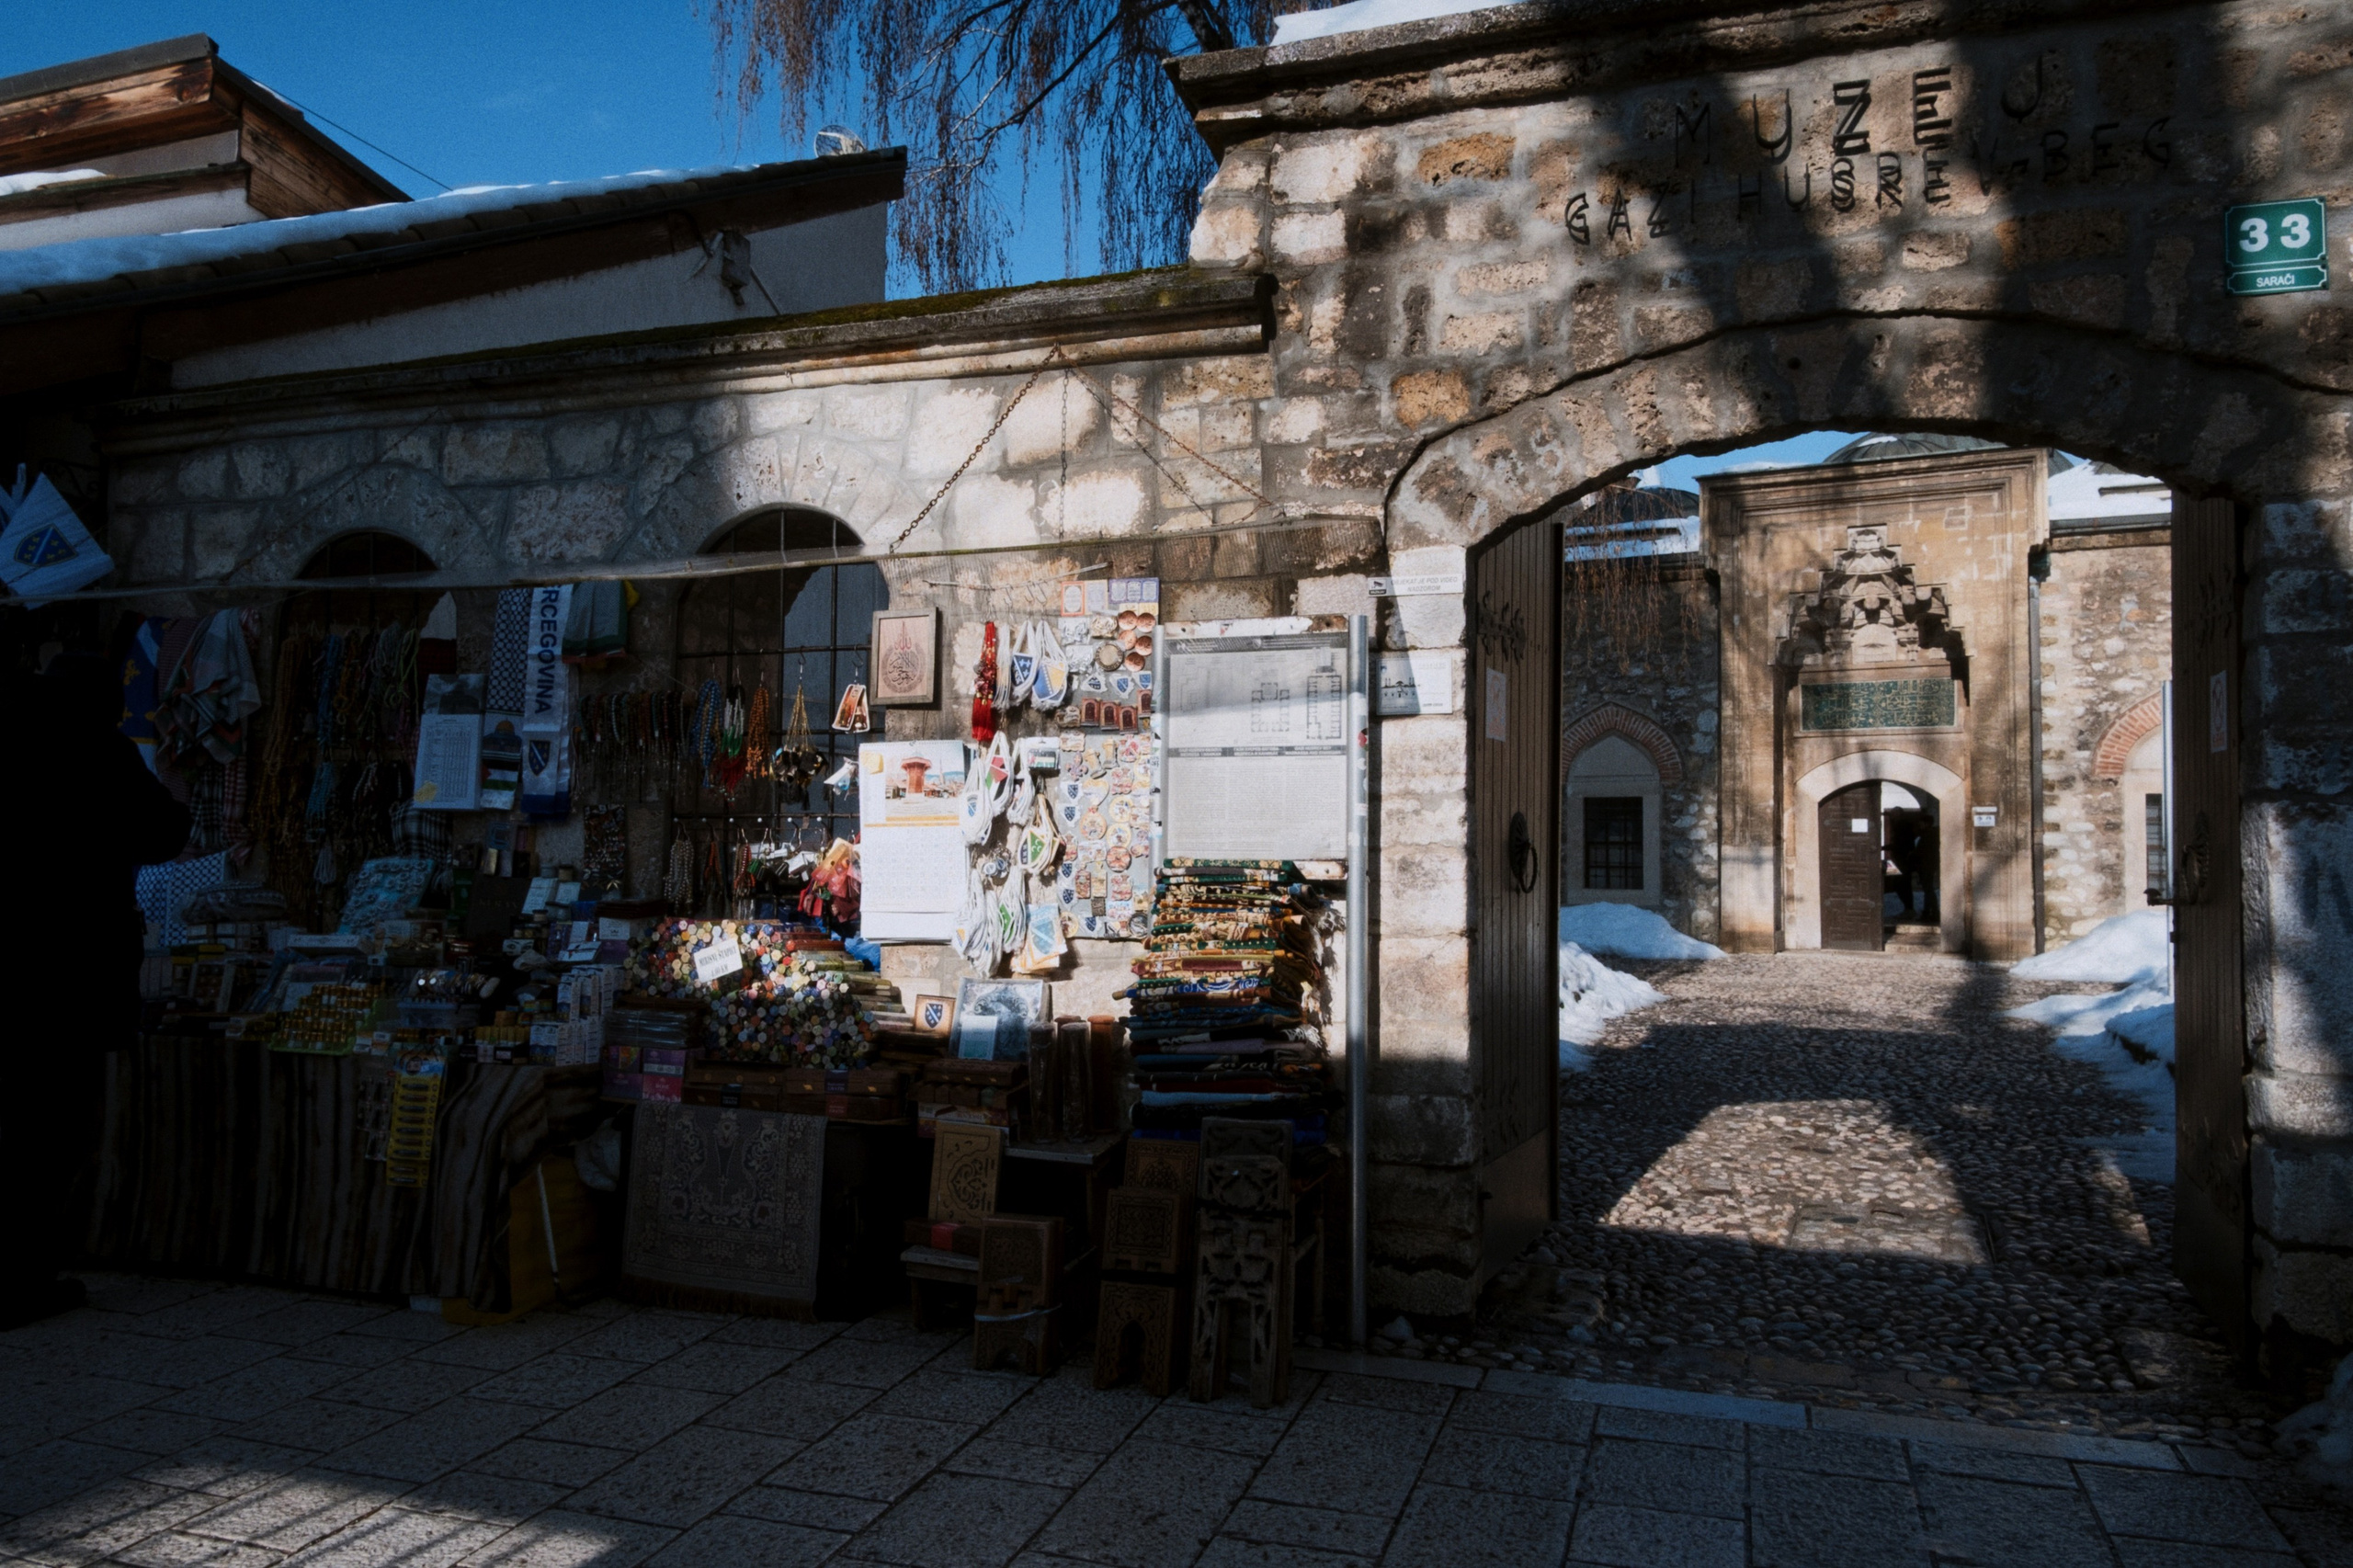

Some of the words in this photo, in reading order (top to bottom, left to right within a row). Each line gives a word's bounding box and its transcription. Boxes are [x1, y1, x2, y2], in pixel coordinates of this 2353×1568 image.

[1675, 53, 2042, 168] MUZEJ
[1564, 177, 1697, 242] GAZI
[2238, 213, 2311, 253] 33
[2256, 273, 2295, 288] SARAČI
[535, 584, 561, 714] RCEGOVINA
